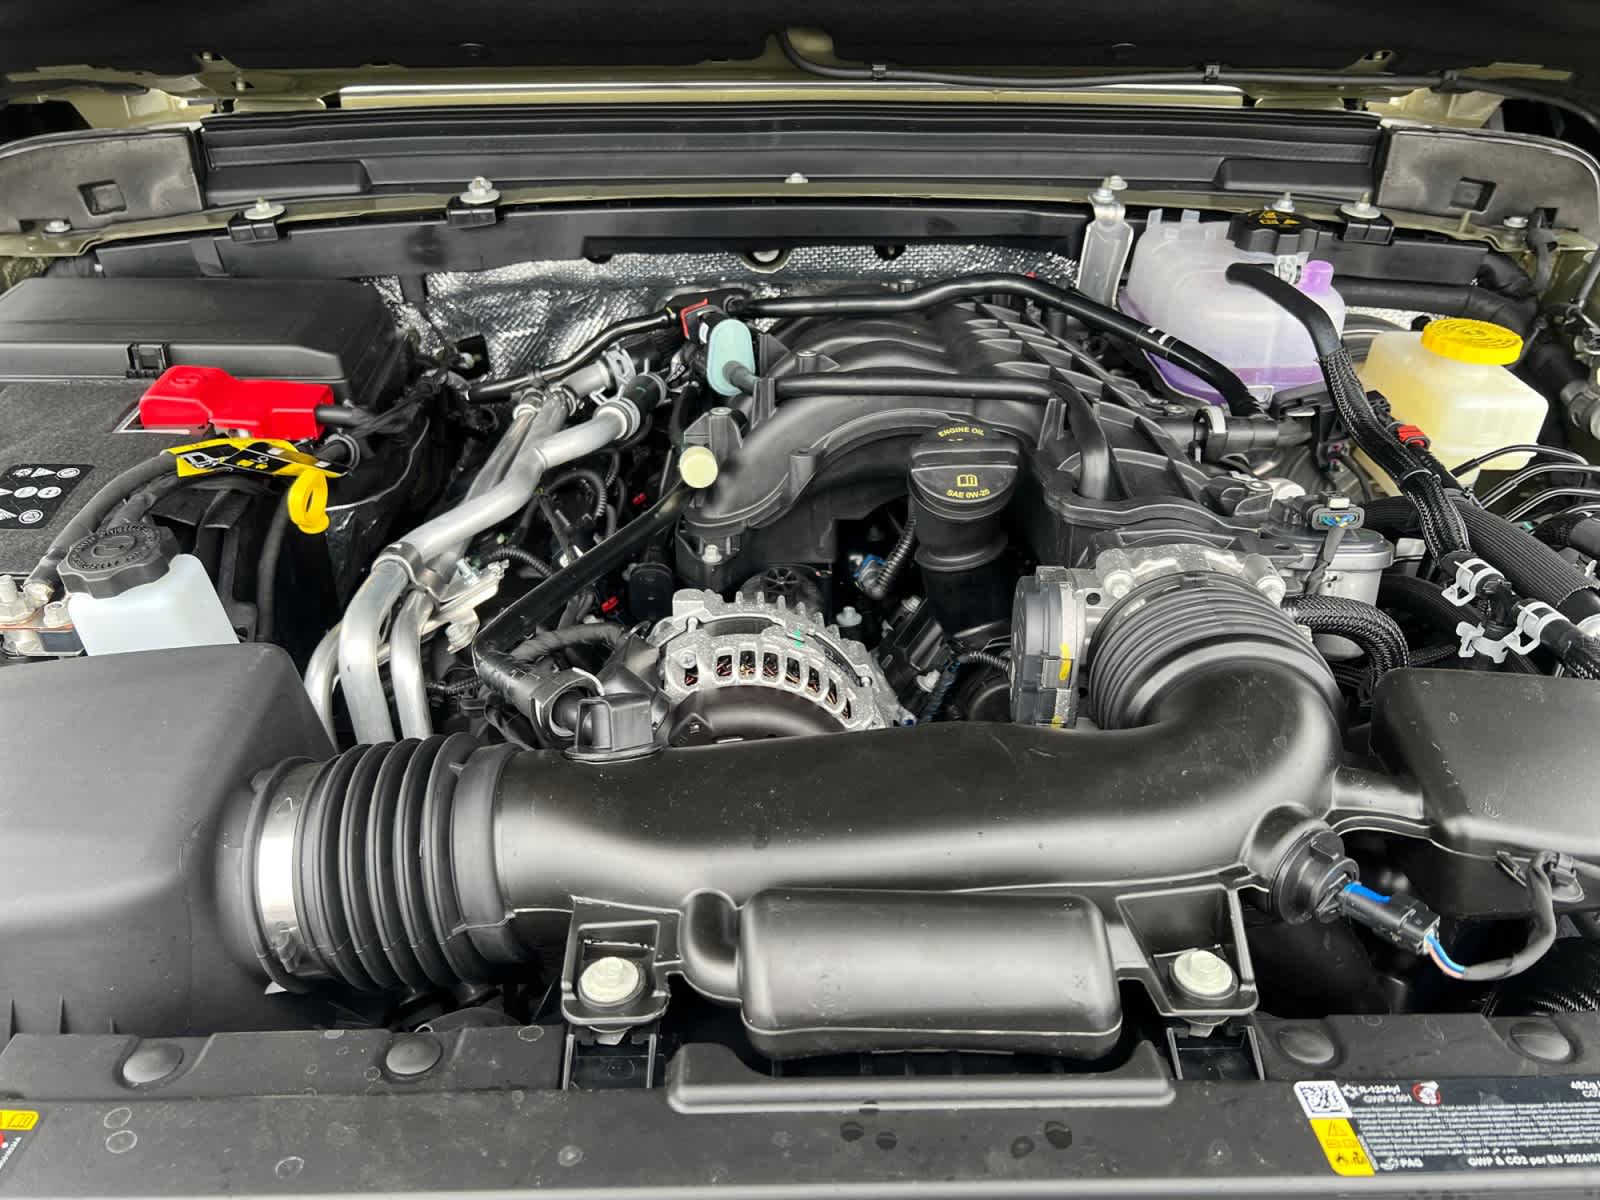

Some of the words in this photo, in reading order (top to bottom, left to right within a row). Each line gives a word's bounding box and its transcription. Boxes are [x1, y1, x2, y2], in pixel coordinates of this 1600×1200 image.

[937, 426, 969, 437] ENGINE
[971, 427, 984, 436] OIL
[946, 489, 965, 498] SAE
